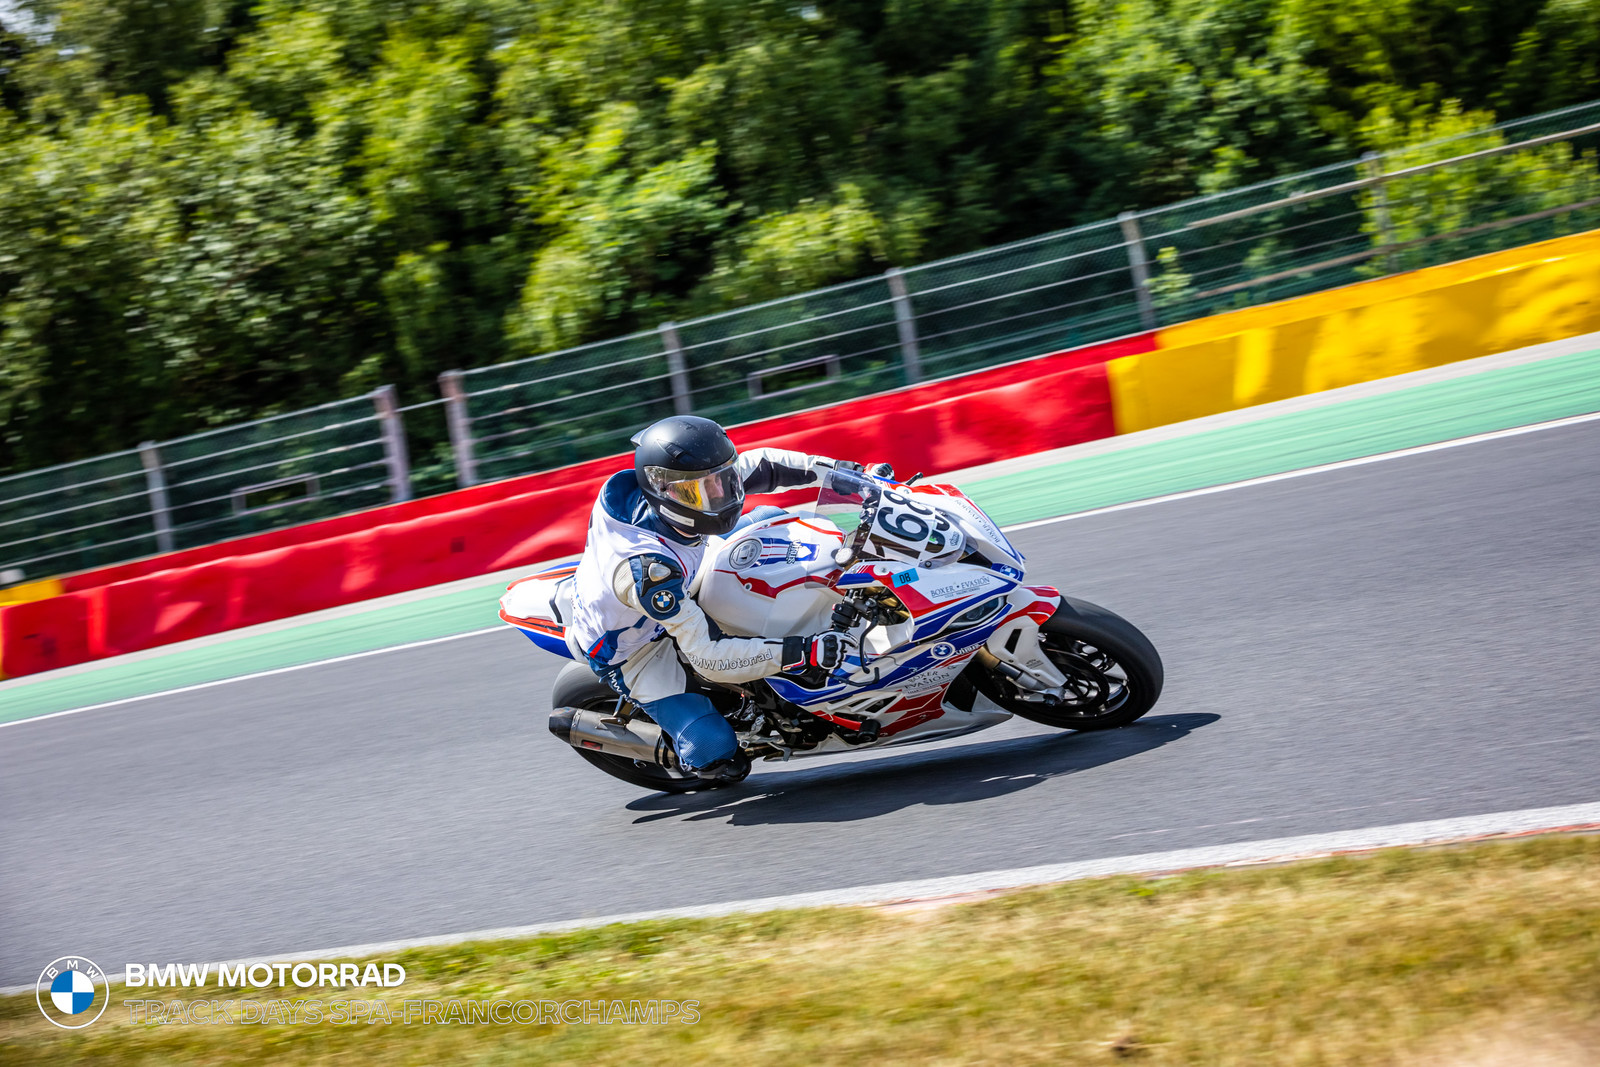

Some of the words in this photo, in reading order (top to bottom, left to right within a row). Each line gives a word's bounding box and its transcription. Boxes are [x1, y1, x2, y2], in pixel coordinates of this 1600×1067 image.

[869, 490, 934, 560] 168
[930, 585, 956, 597] BOXER
[718, 648, 774, 671] Motorrad
